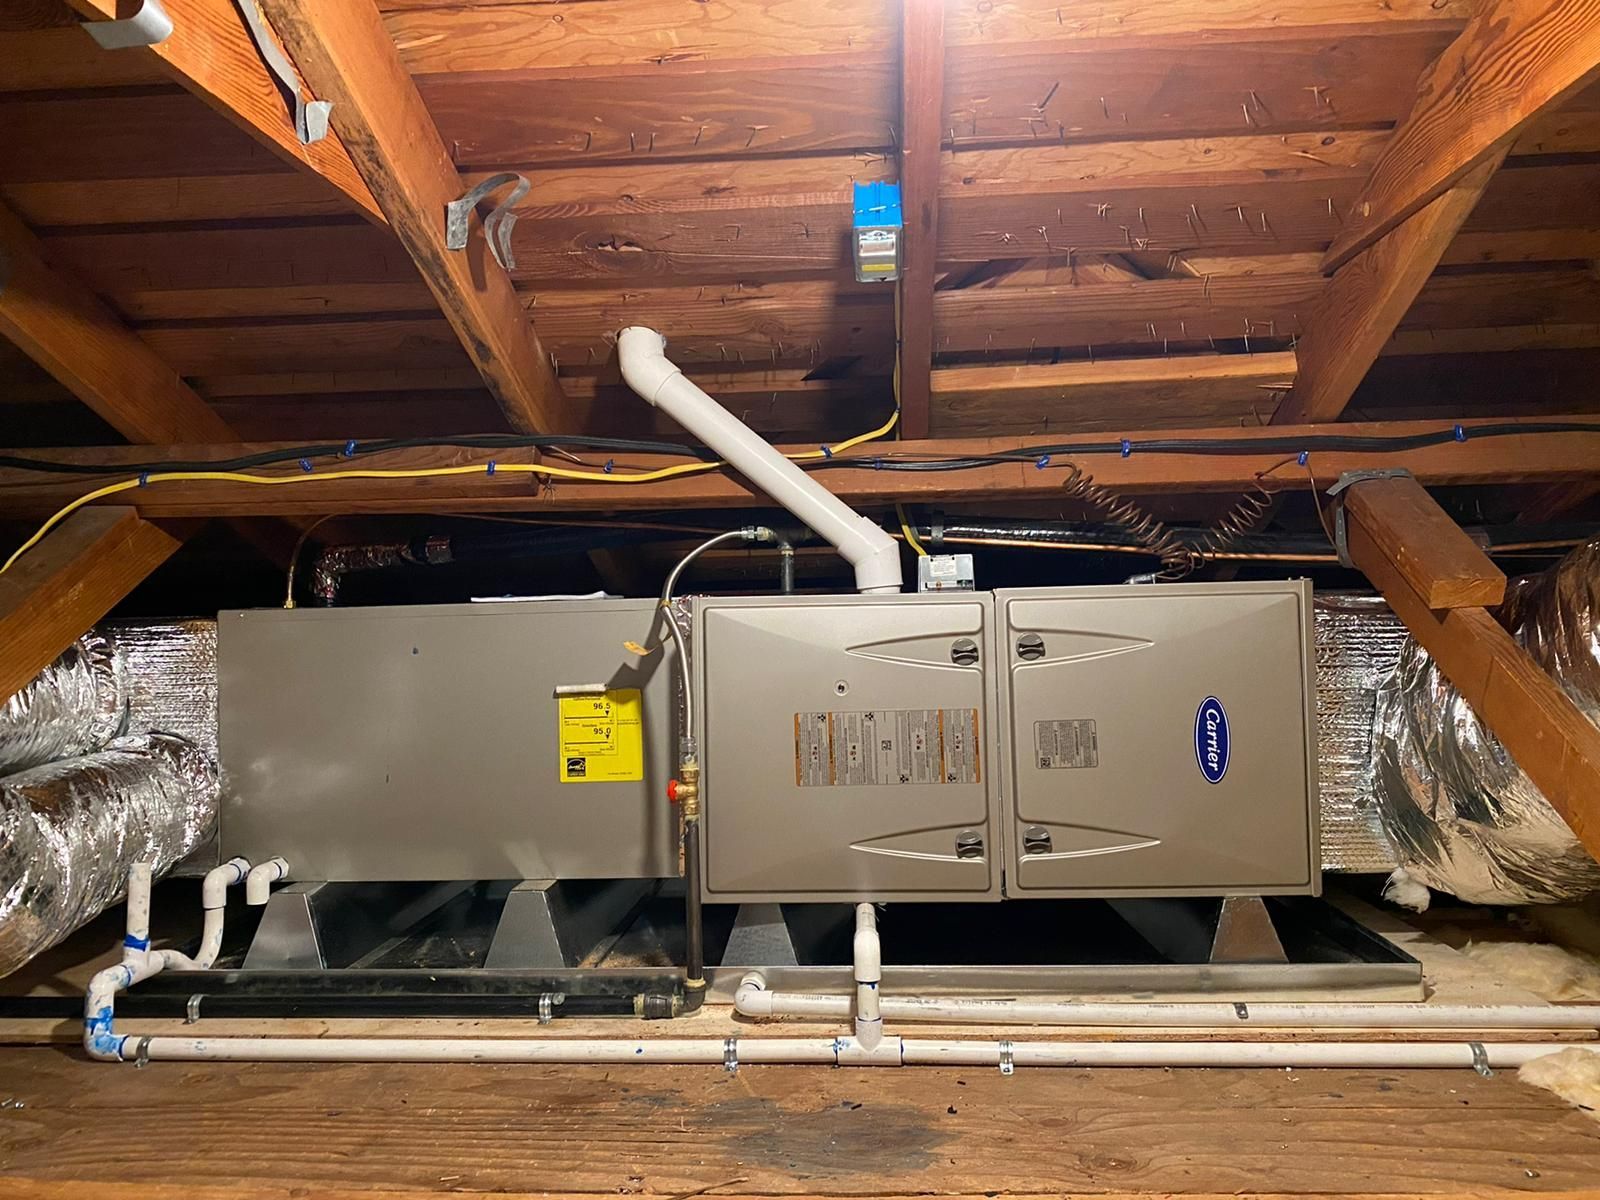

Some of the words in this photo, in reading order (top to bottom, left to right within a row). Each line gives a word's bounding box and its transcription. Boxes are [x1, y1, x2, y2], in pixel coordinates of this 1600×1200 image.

[593, 702, 611, 710] 96.5
[593, 727, 612, 735] 95.0
[1205, 708, 1220, 772] Carrier
